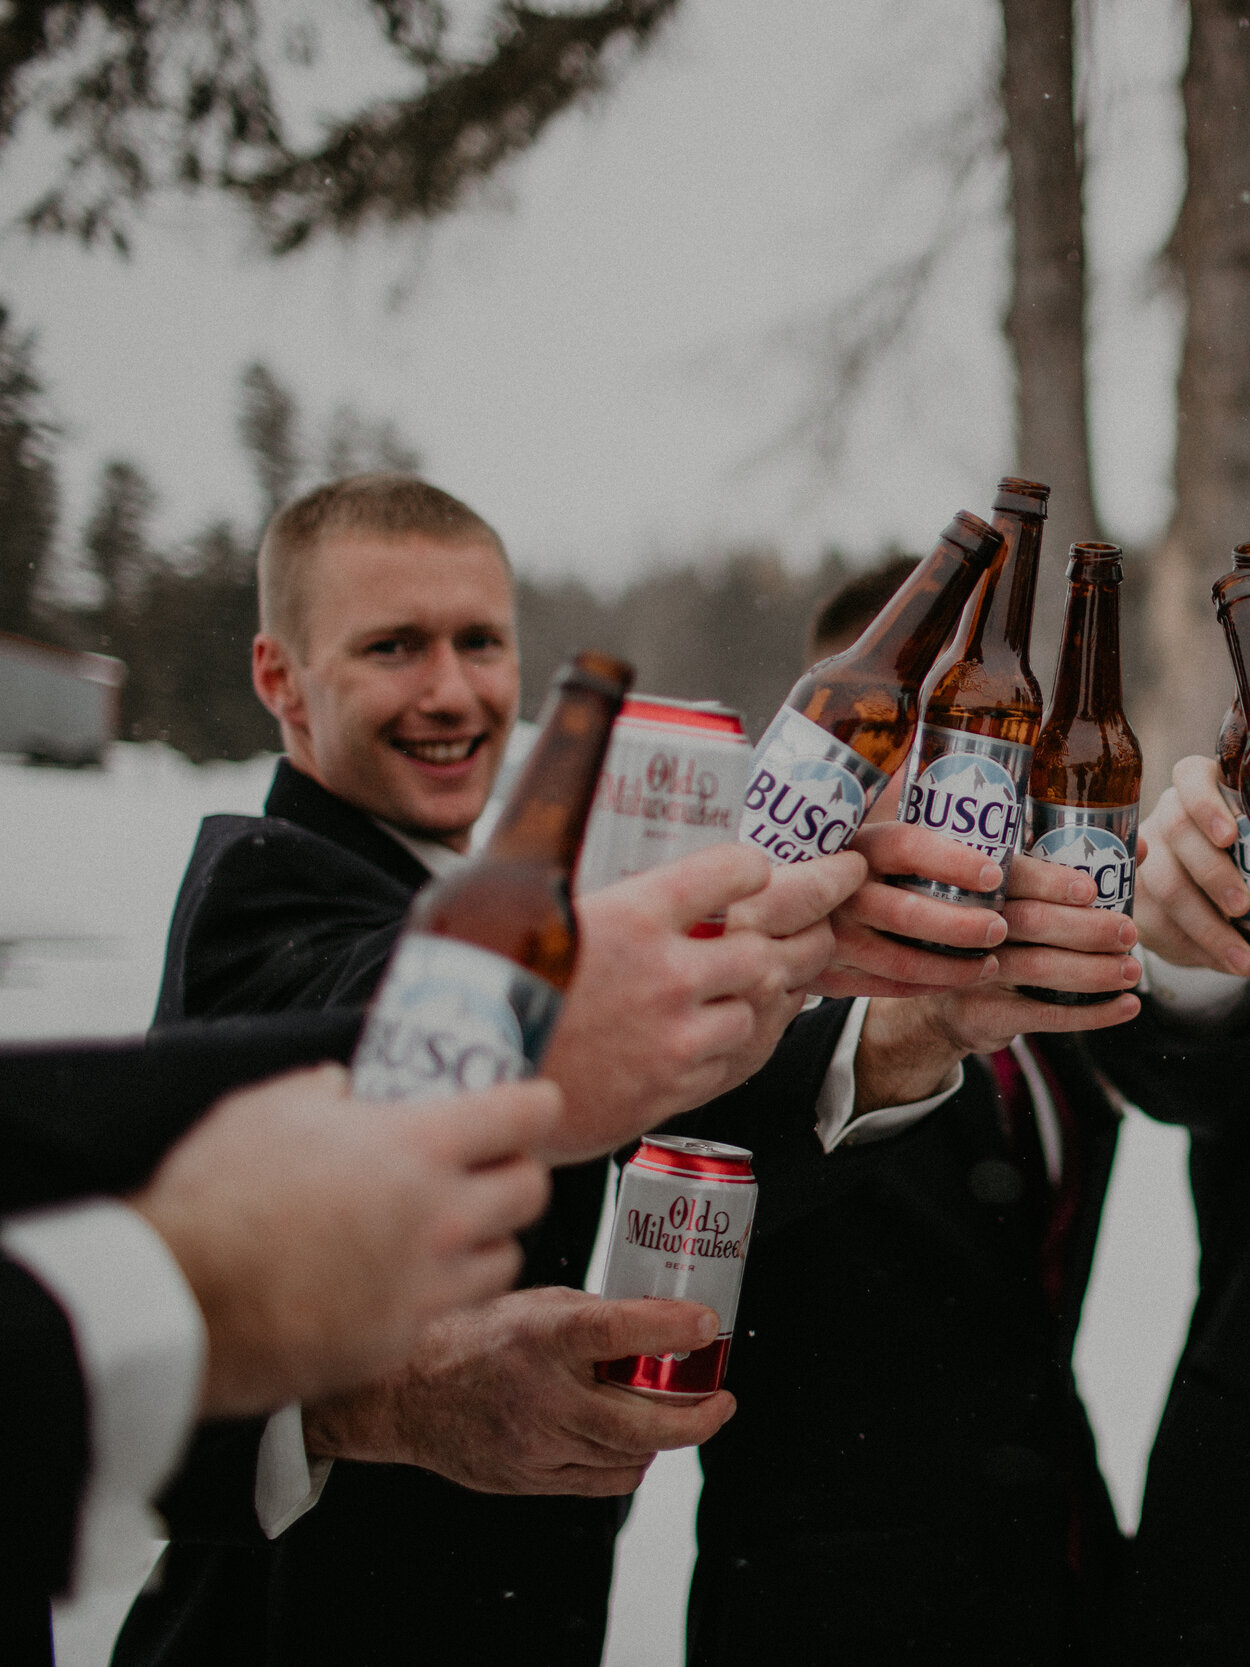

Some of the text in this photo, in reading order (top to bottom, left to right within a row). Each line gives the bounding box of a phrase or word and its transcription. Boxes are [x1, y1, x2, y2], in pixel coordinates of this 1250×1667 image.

[904, 784, 1021, 847] BUSCH
[749, 824, 815, 864] LIGH
[625, 1209, 741, 1259] Milwaukee
[669, 1196, 730, 1235] Old
[665, 1261, 696, 1272] BEER
